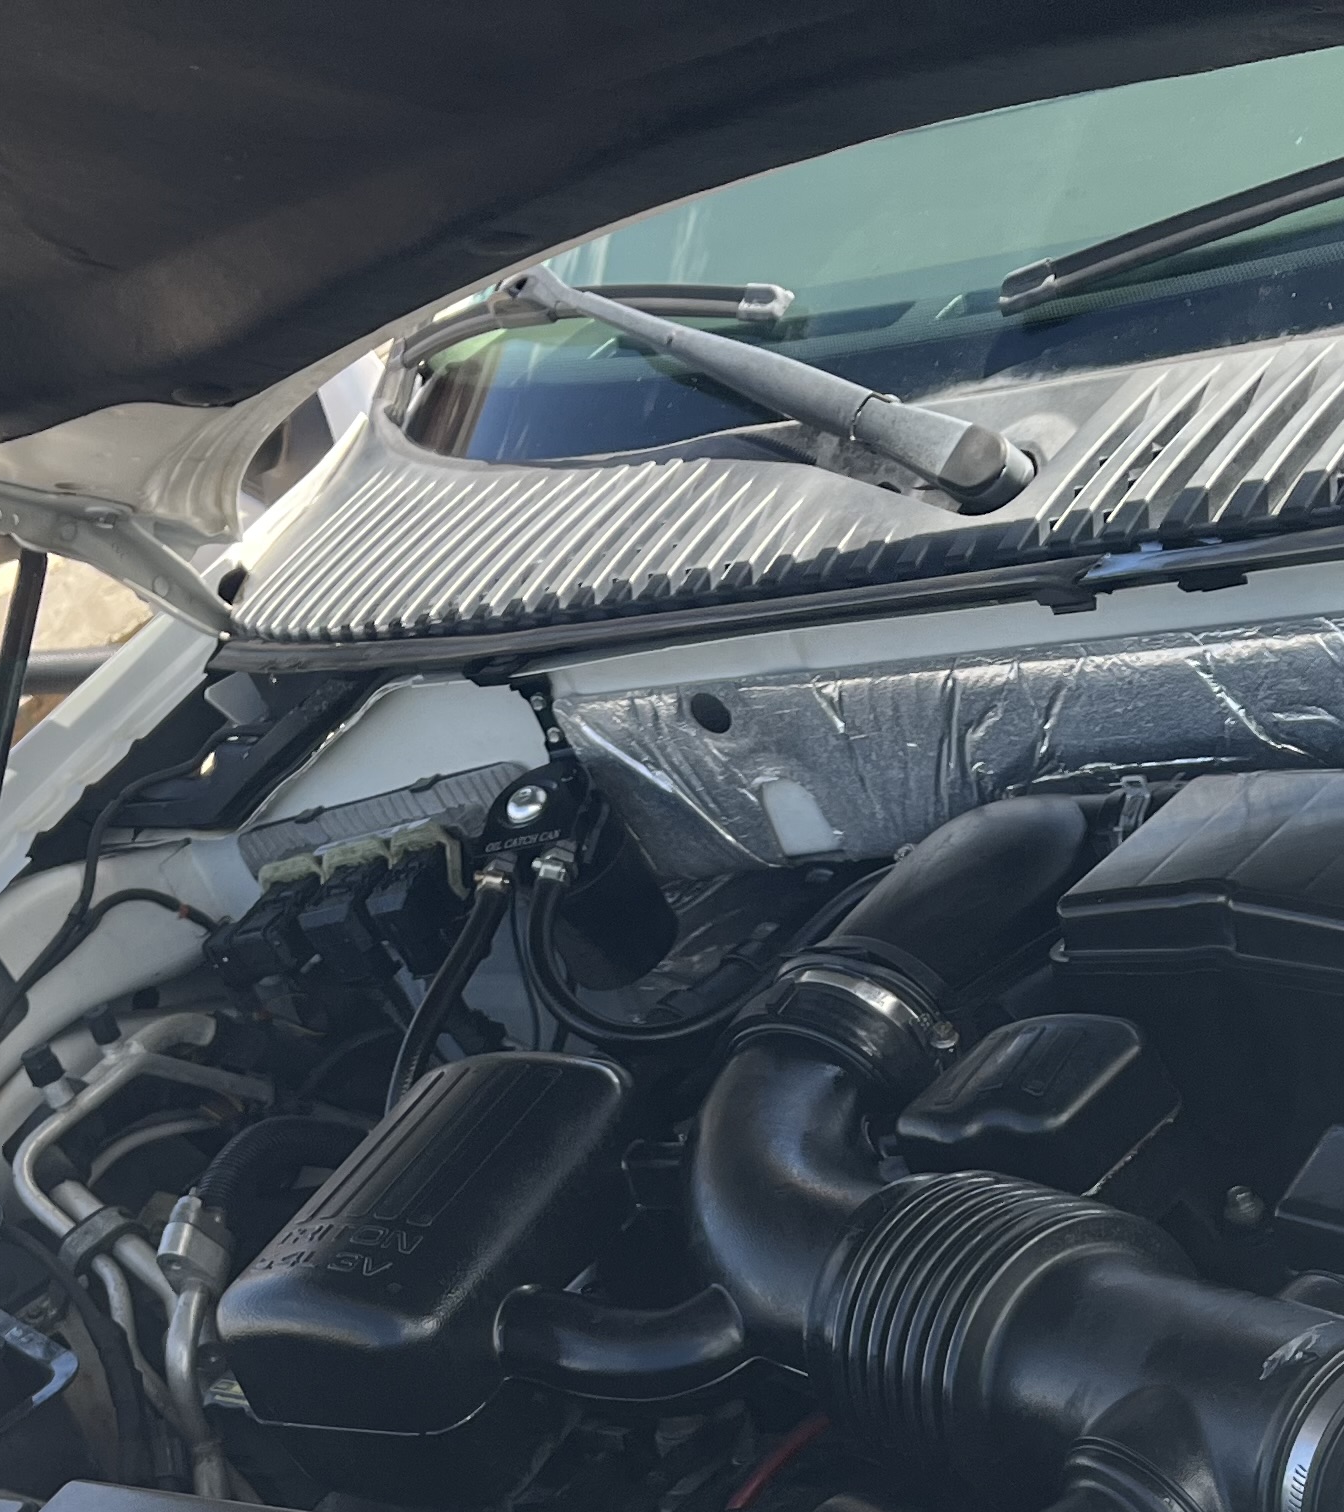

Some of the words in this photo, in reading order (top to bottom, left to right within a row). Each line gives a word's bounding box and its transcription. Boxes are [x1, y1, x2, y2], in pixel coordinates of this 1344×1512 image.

[504, 833, 539, 849] CATCH
[539, 829, 561, 842] CAN
[277, 1223, 424, 1255] TRITON
[327, 1251, 394, 1277] 3V
